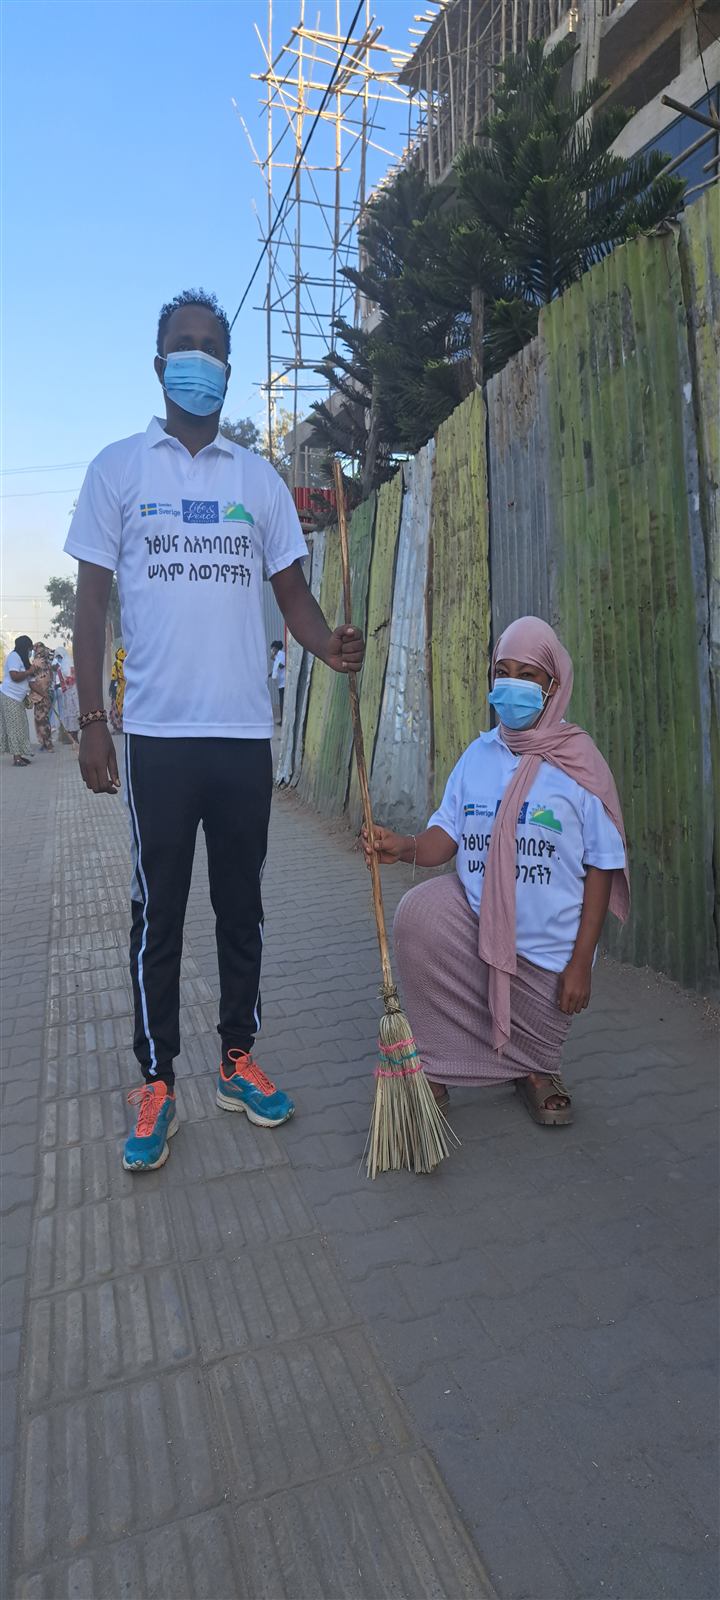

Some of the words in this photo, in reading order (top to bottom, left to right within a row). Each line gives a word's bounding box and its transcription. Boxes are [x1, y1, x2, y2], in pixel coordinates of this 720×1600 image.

[158, 508, 181, 517] Sverige
[148, 562, 184, 582] ሠላም
[475, 809, 494, 818] Sverige
[468, 859, 486, 878] ሠላ
